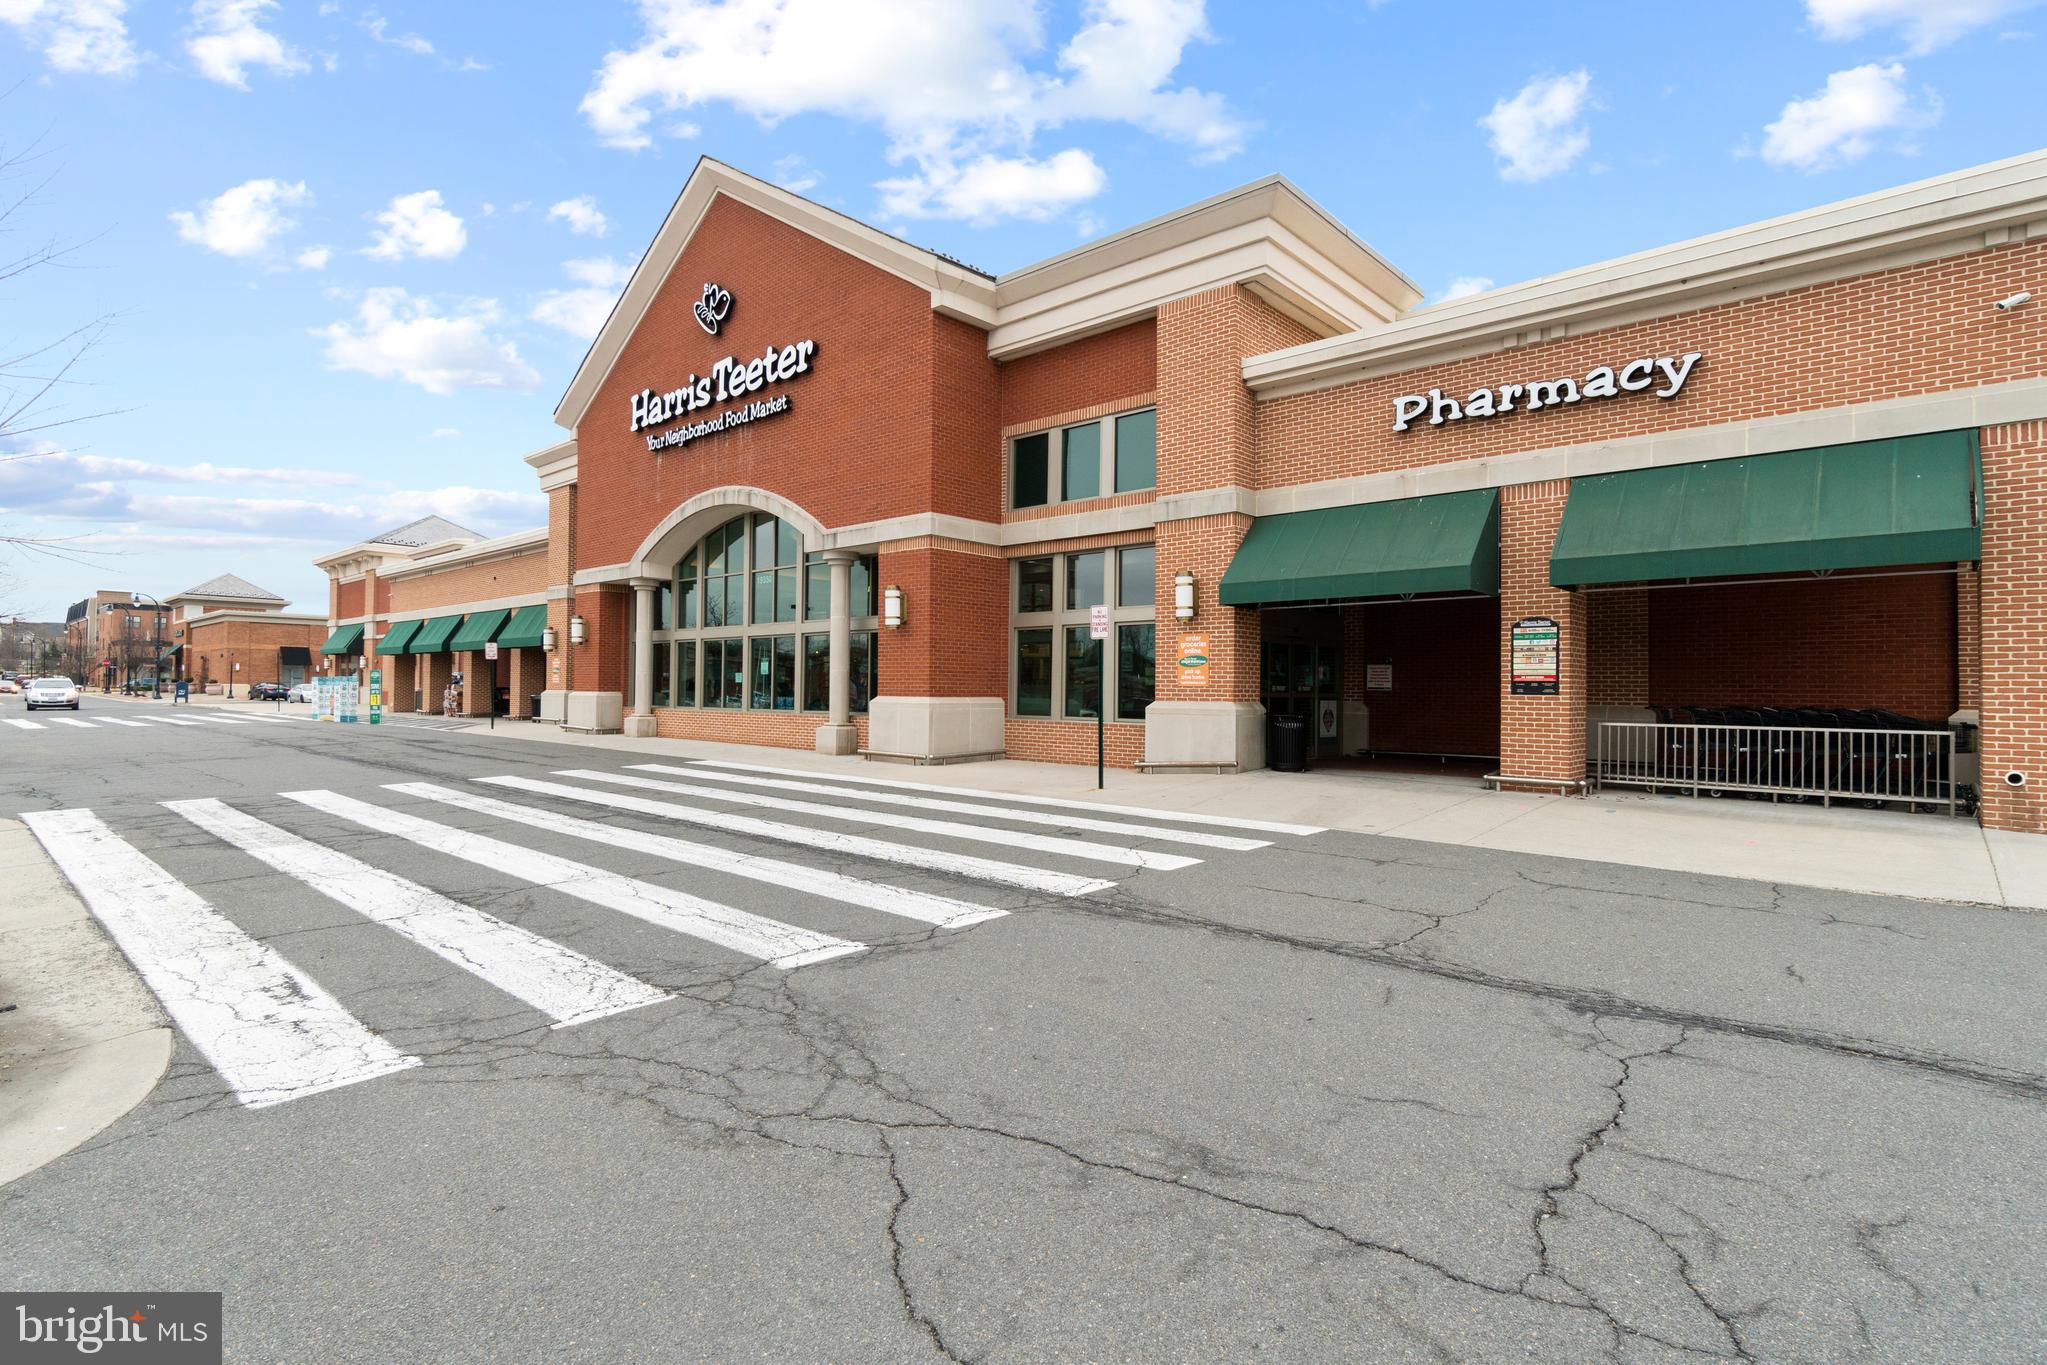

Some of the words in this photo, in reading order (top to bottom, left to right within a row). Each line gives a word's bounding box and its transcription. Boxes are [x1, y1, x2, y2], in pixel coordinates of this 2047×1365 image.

[630, 373, 711, 432] Harris
[712, 339, 814, 402] Teeter
[646, 434, 666, 451] Your
[665, 412, 724, 447] Neighborhood
[725, 404, 749, 429] Food
[749, 394, 788, 422] Market
[1391, 351, 1702, 432] Pharmacy
